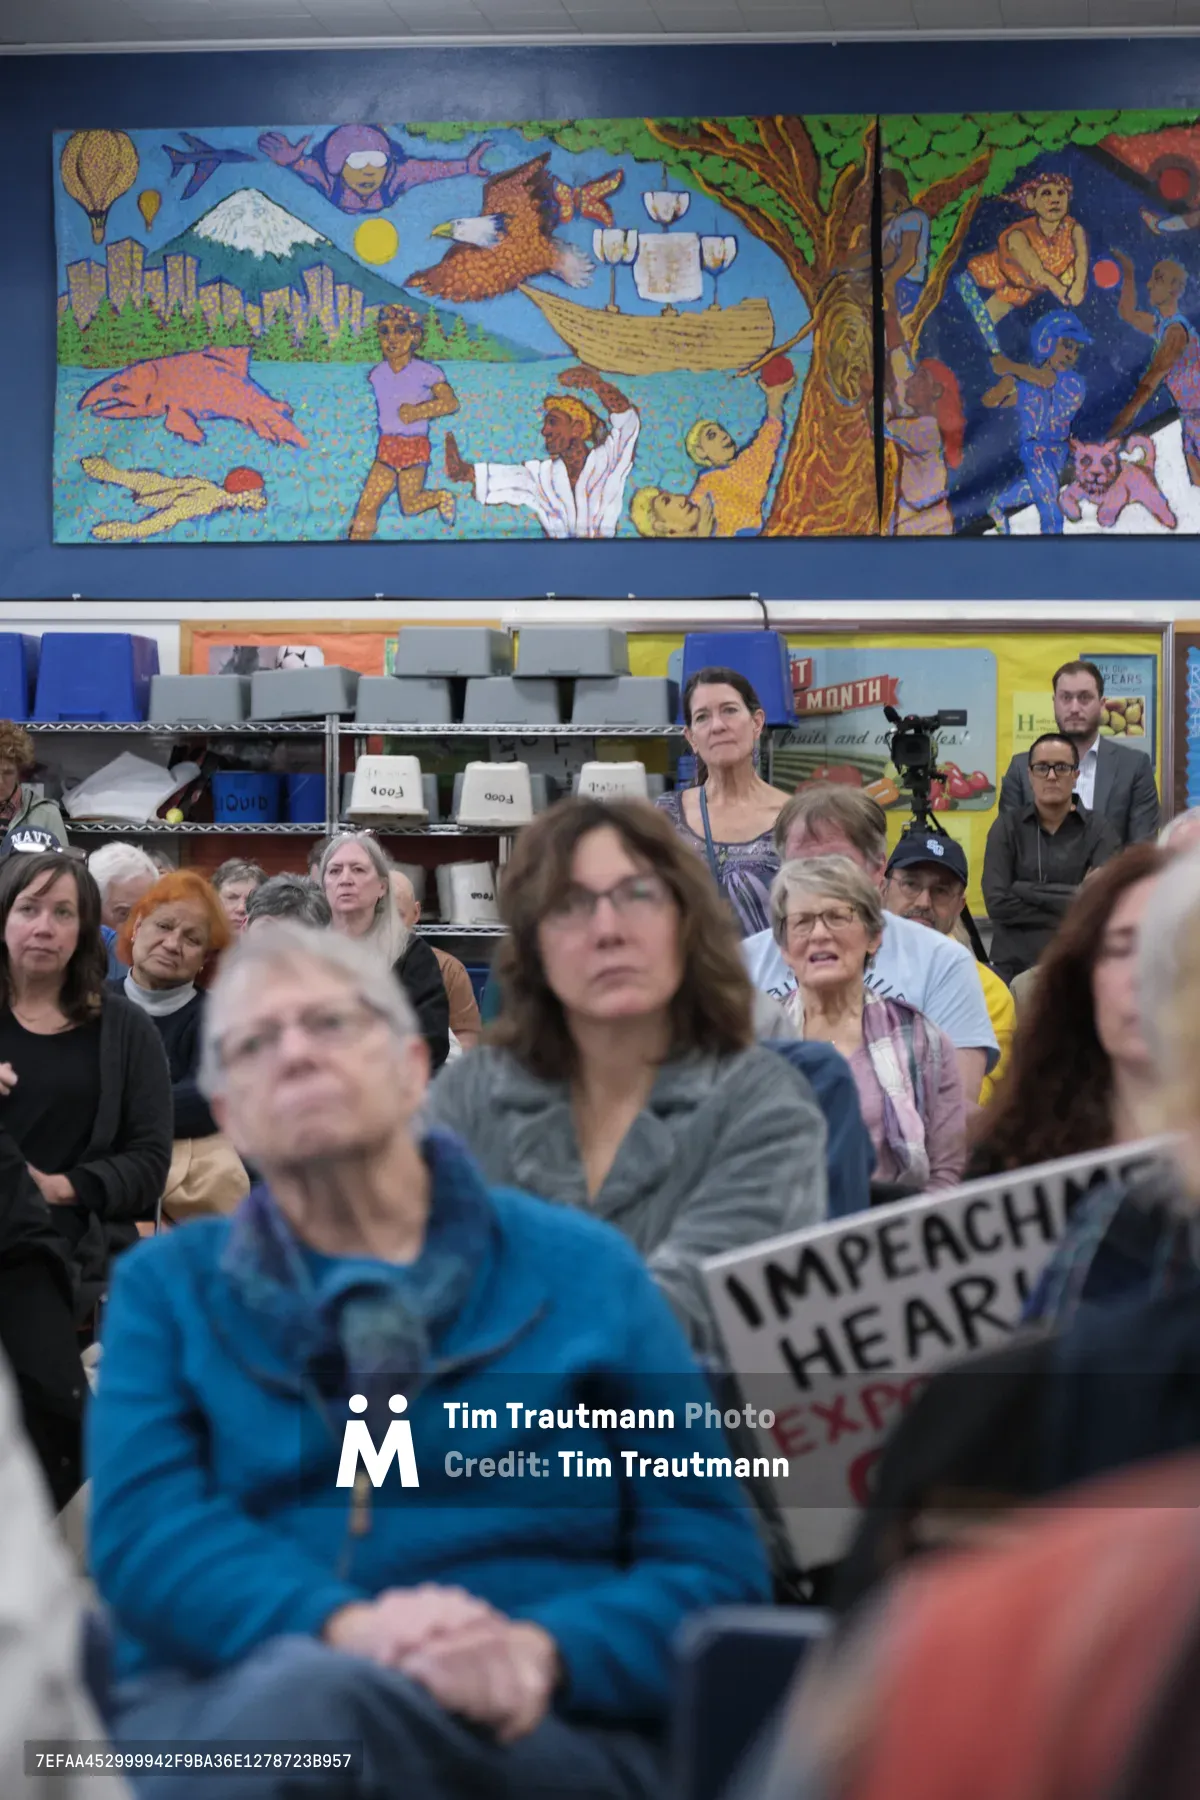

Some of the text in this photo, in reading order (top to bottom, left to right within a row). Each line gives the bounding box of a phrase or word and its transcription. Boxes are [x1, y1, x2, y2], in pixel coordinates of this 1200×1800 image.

[1103, 674, 1142, 685] PEARS
[806, 679, 881, 710] MONTH
[835, 731, 869, 745] and
[371, 785, 404, 799] FOOD
[485, 792, 514, 804] FOOD
[11, 830, 52, 846] NAVY
